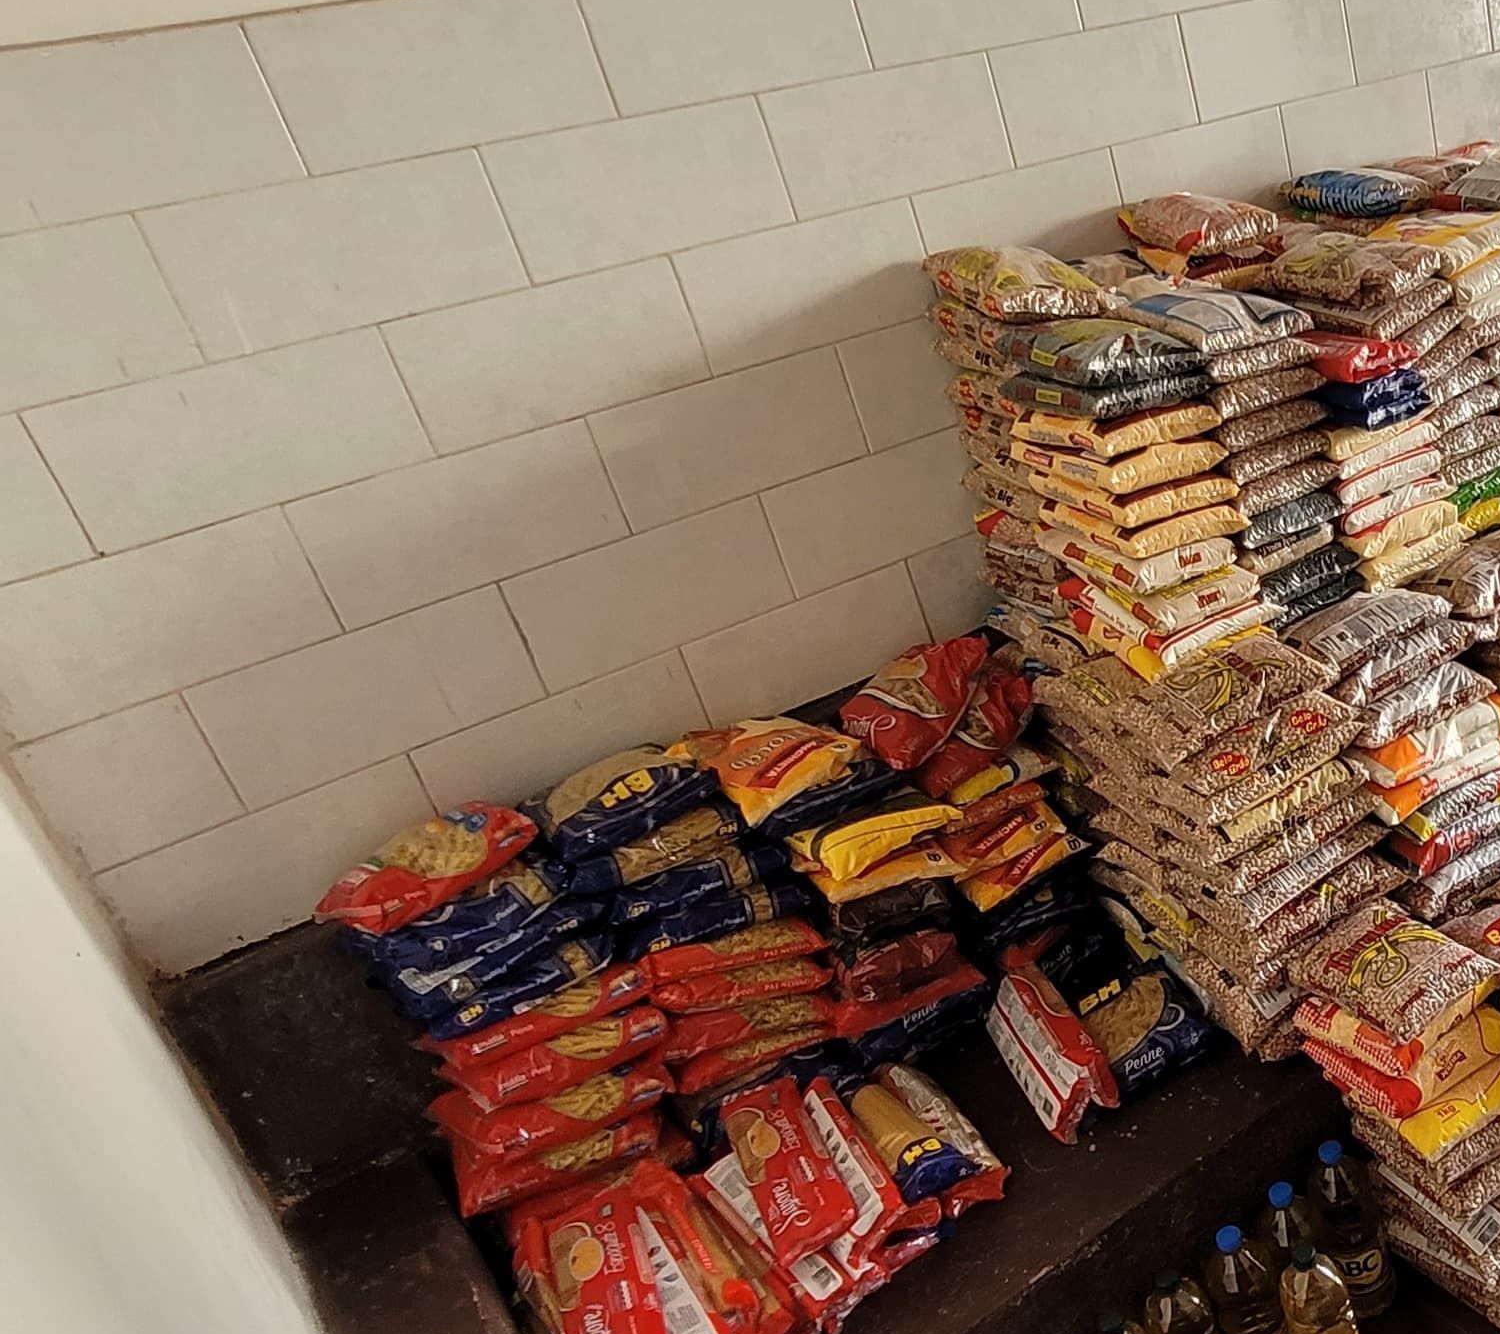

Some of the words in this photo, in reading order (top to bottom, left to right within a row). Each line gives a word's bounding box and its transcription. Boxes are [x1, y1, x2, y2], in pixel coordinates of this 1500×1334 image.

[600, 769, 655, 810] BH
[976, 815, 1024, 852] ANCHIETA
[1079, 979, 1122, 1016] BH
[458, 1004, 485, 1024] BH
[902, 1001, 939, 1028] Penne
[1124, 1046, 1165, 1075] Penne
[766, 1108, 784, 1122] 8
[1437, 1104, 1459, 1118] 1kg
[902, 1137, 943, 1166] BH
[594, 1221, 617, 1235] 8
